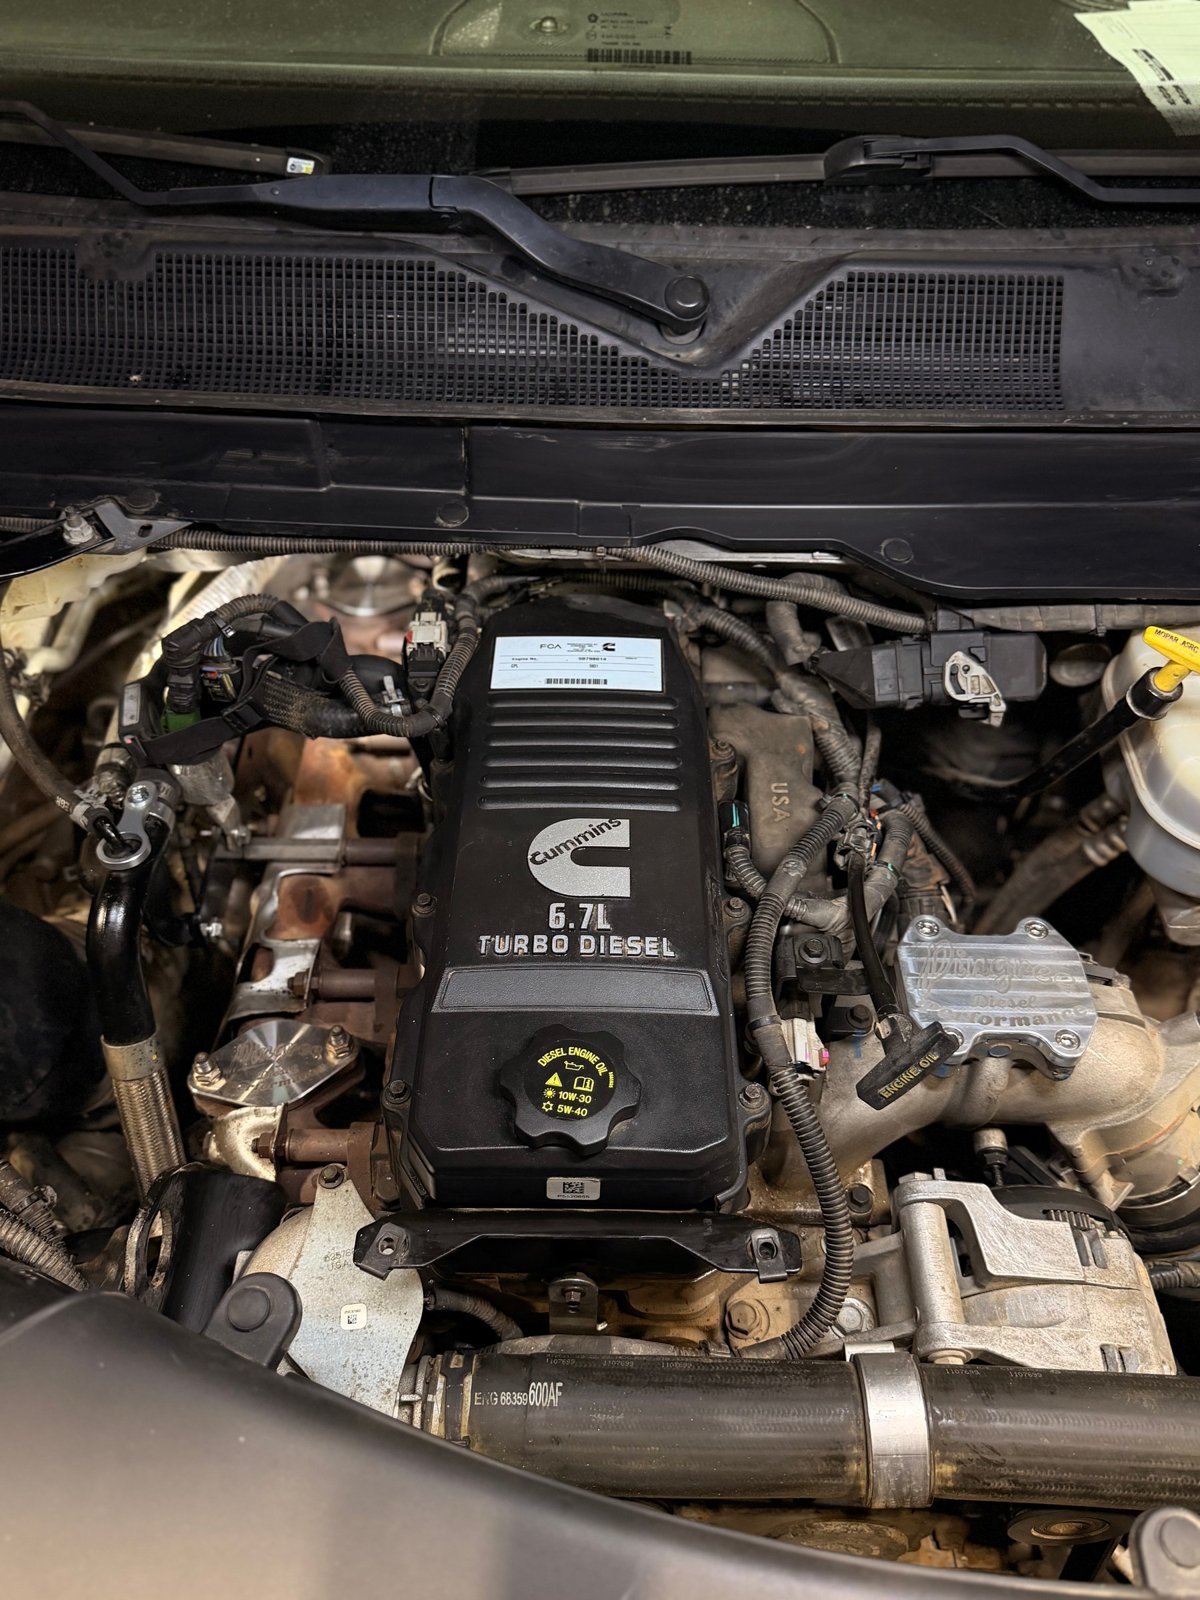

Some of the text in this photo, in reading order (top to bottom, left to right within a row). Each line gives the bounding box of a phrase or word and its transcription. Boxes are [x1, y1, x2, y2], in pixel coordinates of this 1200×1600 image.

[1155, 629, 1199, 653] MOPAR ASRC
[771, 782, 791, 822] USA
[529, 818, 622, 866] Cummins
[548, 902, 612, 930] 6.7L
[479, 934, 676, 957] TURBO DIESEL
[972, 994, 1039, 1009] Diesel
[537, 1046, 609, 1077] DIESEL ENGINE OIL
[878, 1051, 940, 1099] ENGINE OIL
[556, 1104, 588, 1117] 5W-40
[558, 1091, 593, 1104] 10W-30
